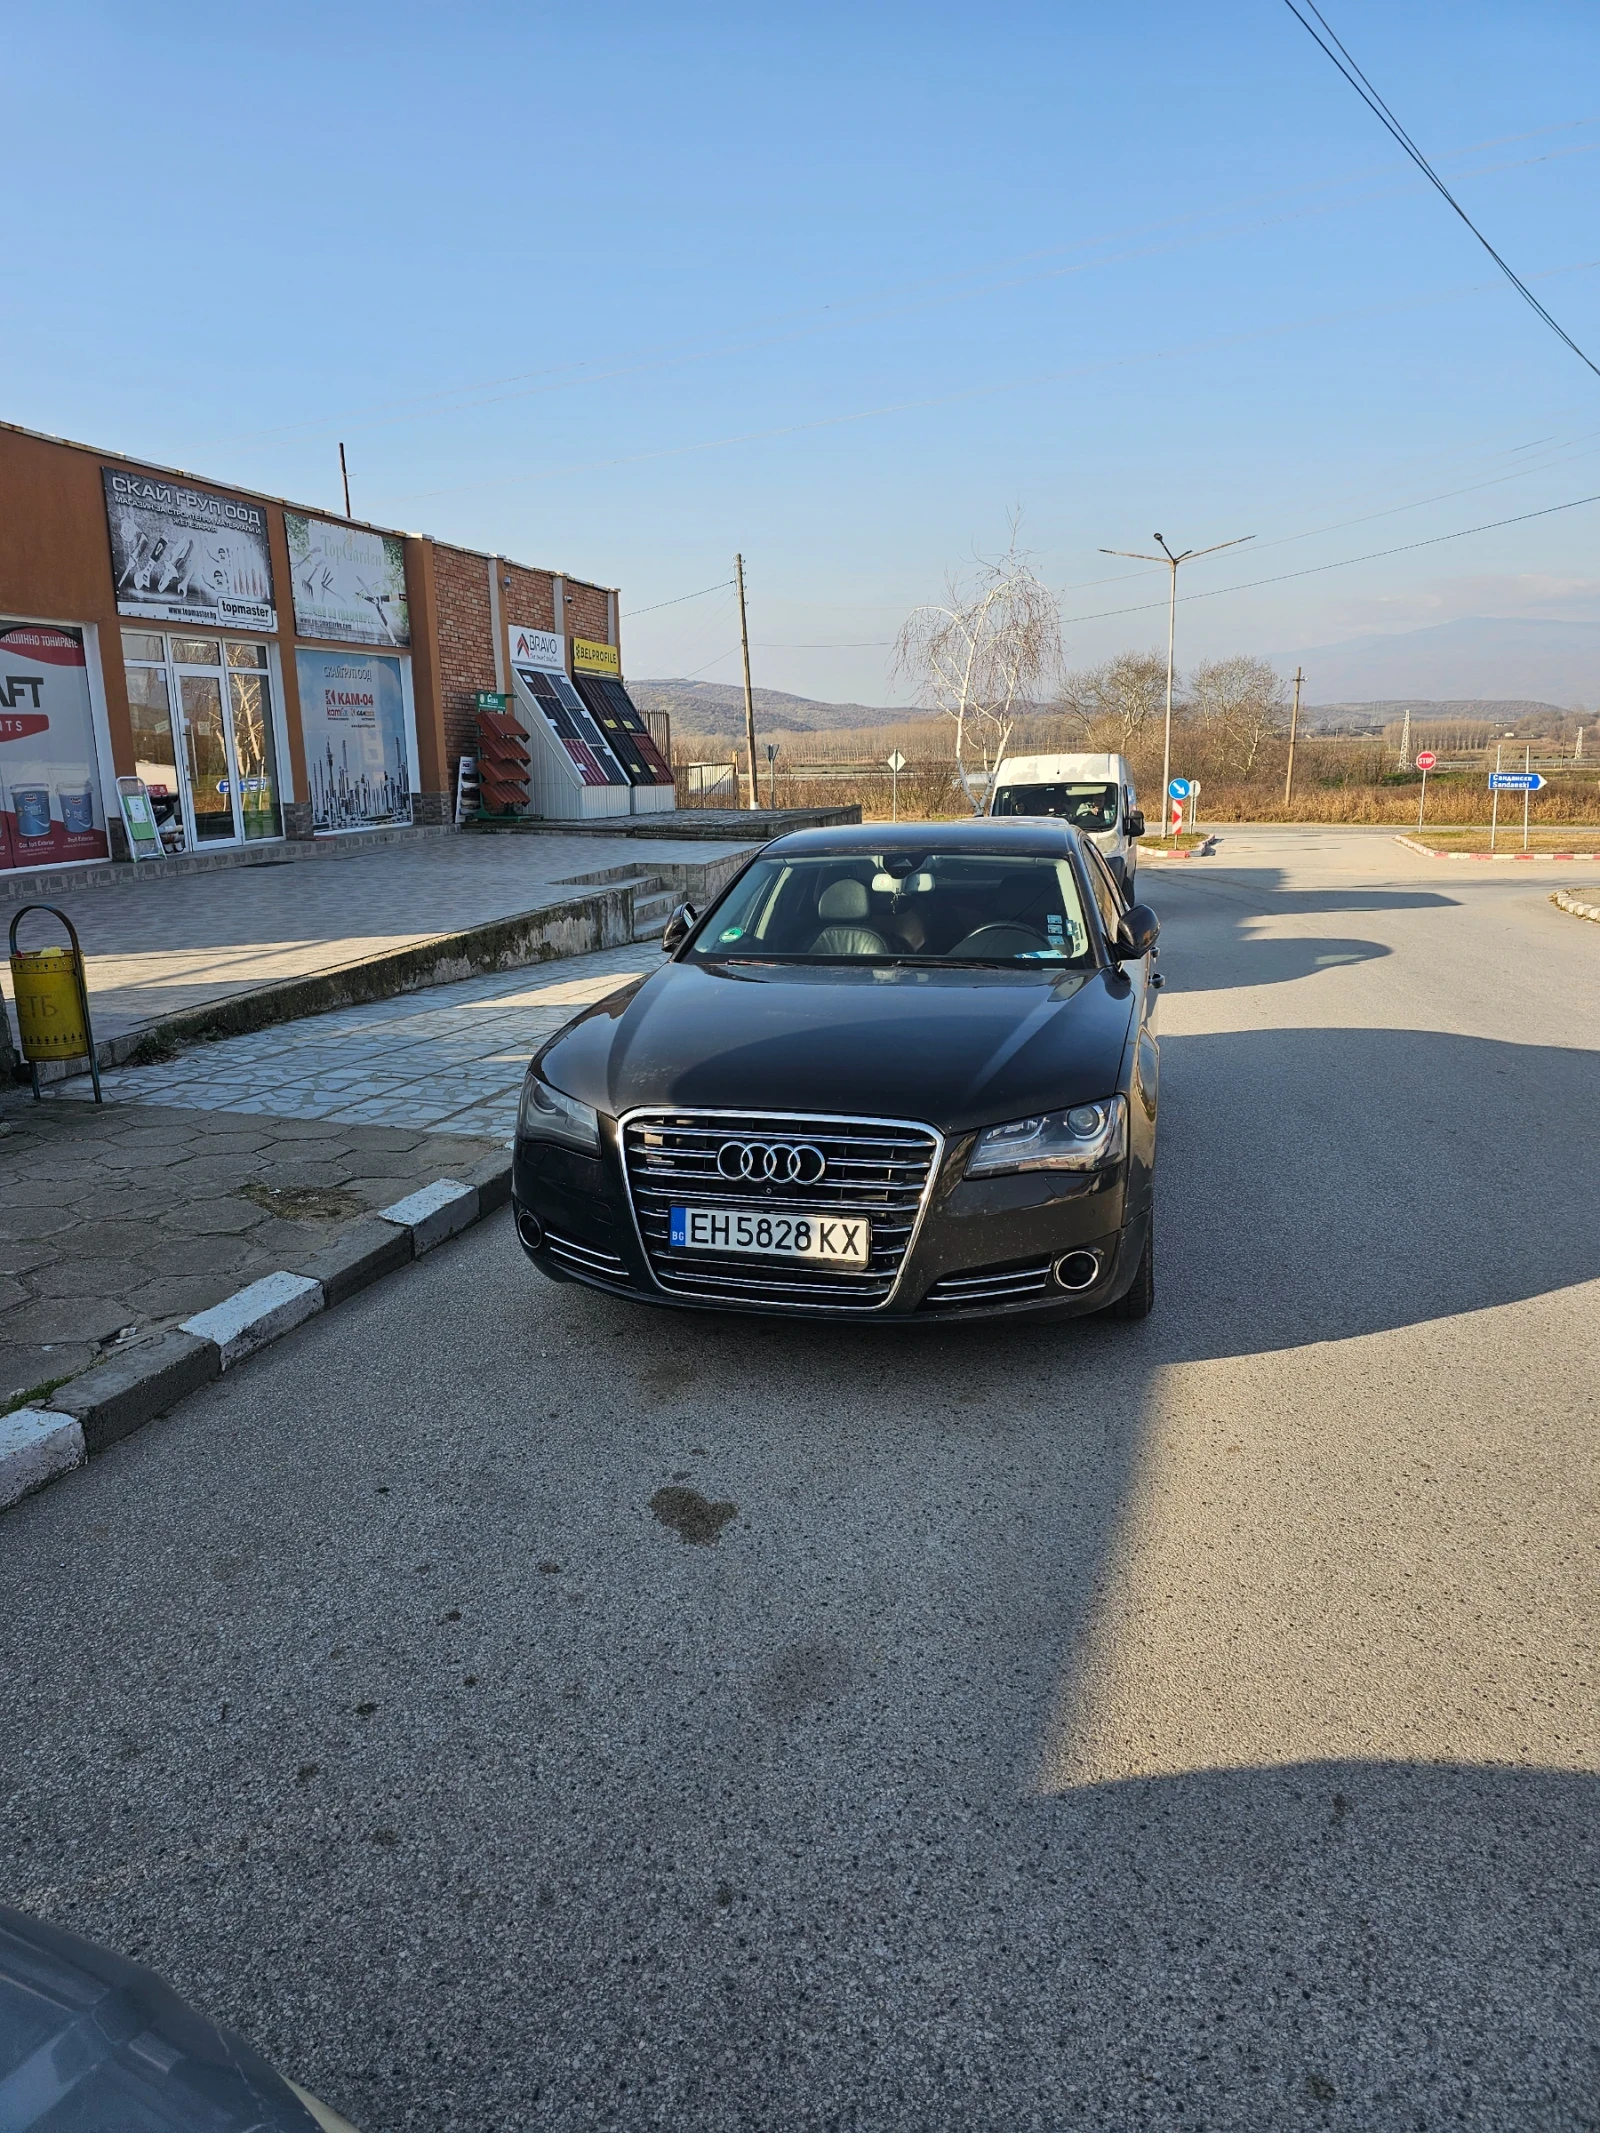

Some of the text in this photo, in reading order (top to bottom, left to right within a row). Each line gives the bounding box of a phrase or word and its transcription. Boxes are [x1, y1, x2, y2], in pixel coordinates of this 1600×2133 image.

[112, 477, 261, 526] СКАЙ ГРУП ООД
[115, 496, 154, 512] МАГАЗИН
[156, 506, 168, 515] ЗА
[168, 508, 214, 524] СТРОИТЕЛНИ
[214, 517, 254, 533] МАТЕРИАЛИ
[173, 518, 217, 533] ЖЕЛЕЗАРИЯ
[320, 535, 381, 567] TopGarden
[168, 607, 217, 620] www.topmaster.bg
[222, 600, 269, 618] topmaster
[41, 636, 79, 648] ТОНИРАНЕ
[529, 635, 557, 654] BRAVO
[580, 647, 617, 664] BELPROFILE
[1418, 757, 1434, 765] STOP
[1492, 774, 1533, 782] Сандански
[672, 1230, 684, 1241] BG
[736, 1216, 812, 1251] 5828
